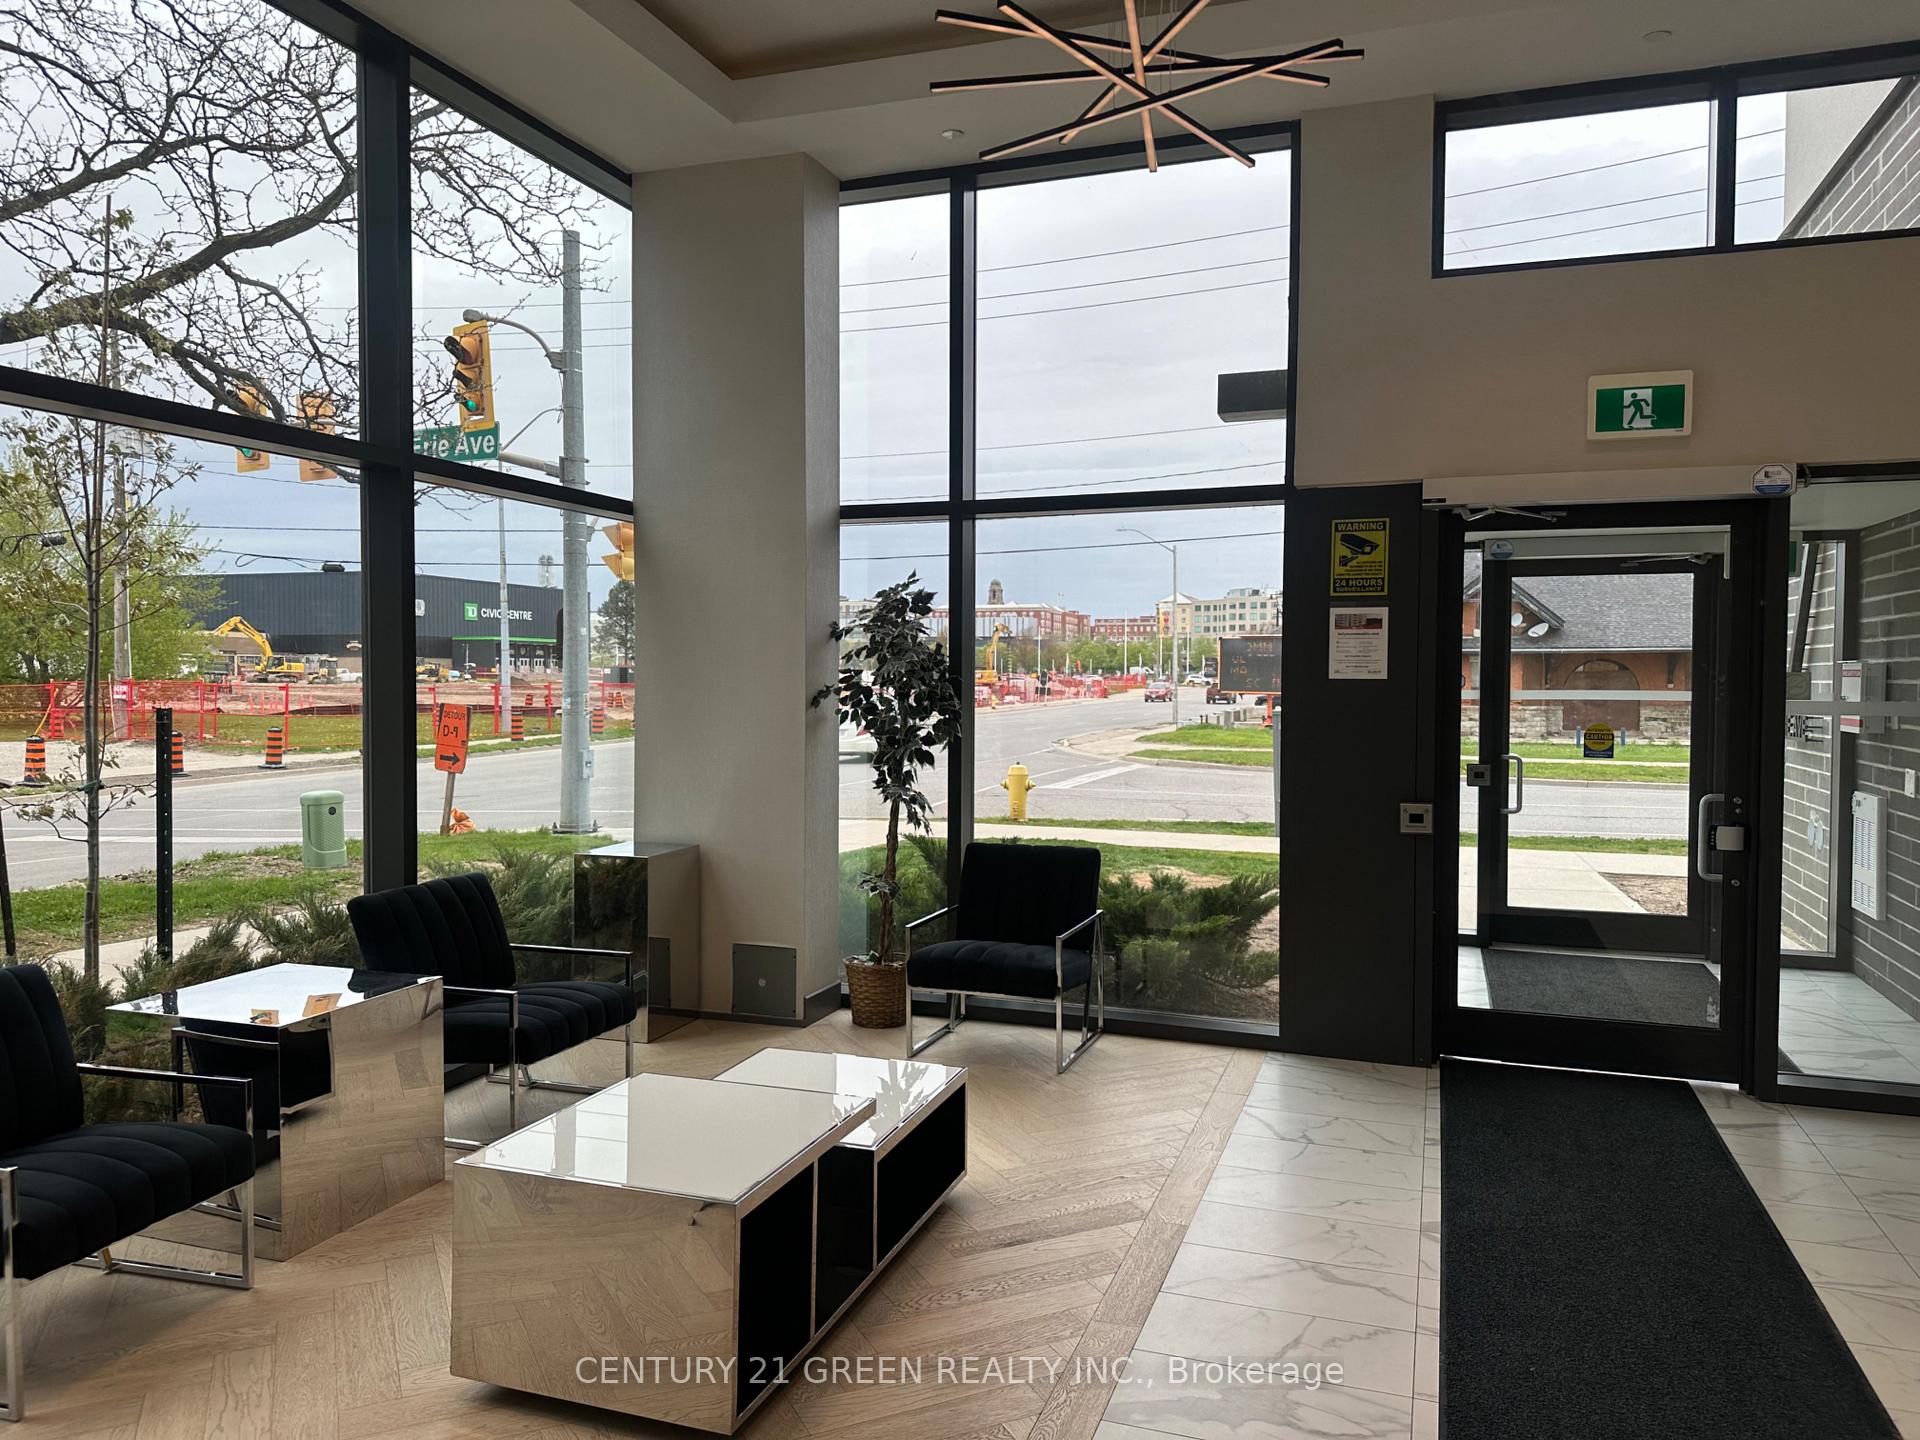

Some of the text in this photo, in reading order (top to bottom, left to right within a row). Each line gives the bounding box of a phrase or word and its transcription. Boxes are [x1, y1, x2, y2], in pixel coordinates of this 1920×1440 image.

[455, 432, 495, 456] Ave
[1338, 522, 1384, 530] WARNING
[1335, 578, 1383, 587] 24 HOURS
[480, 608, 501, 619] CIVIC
[443, 711, 466, 720] DETOUR
[443, 725, 459, 738] D-9
